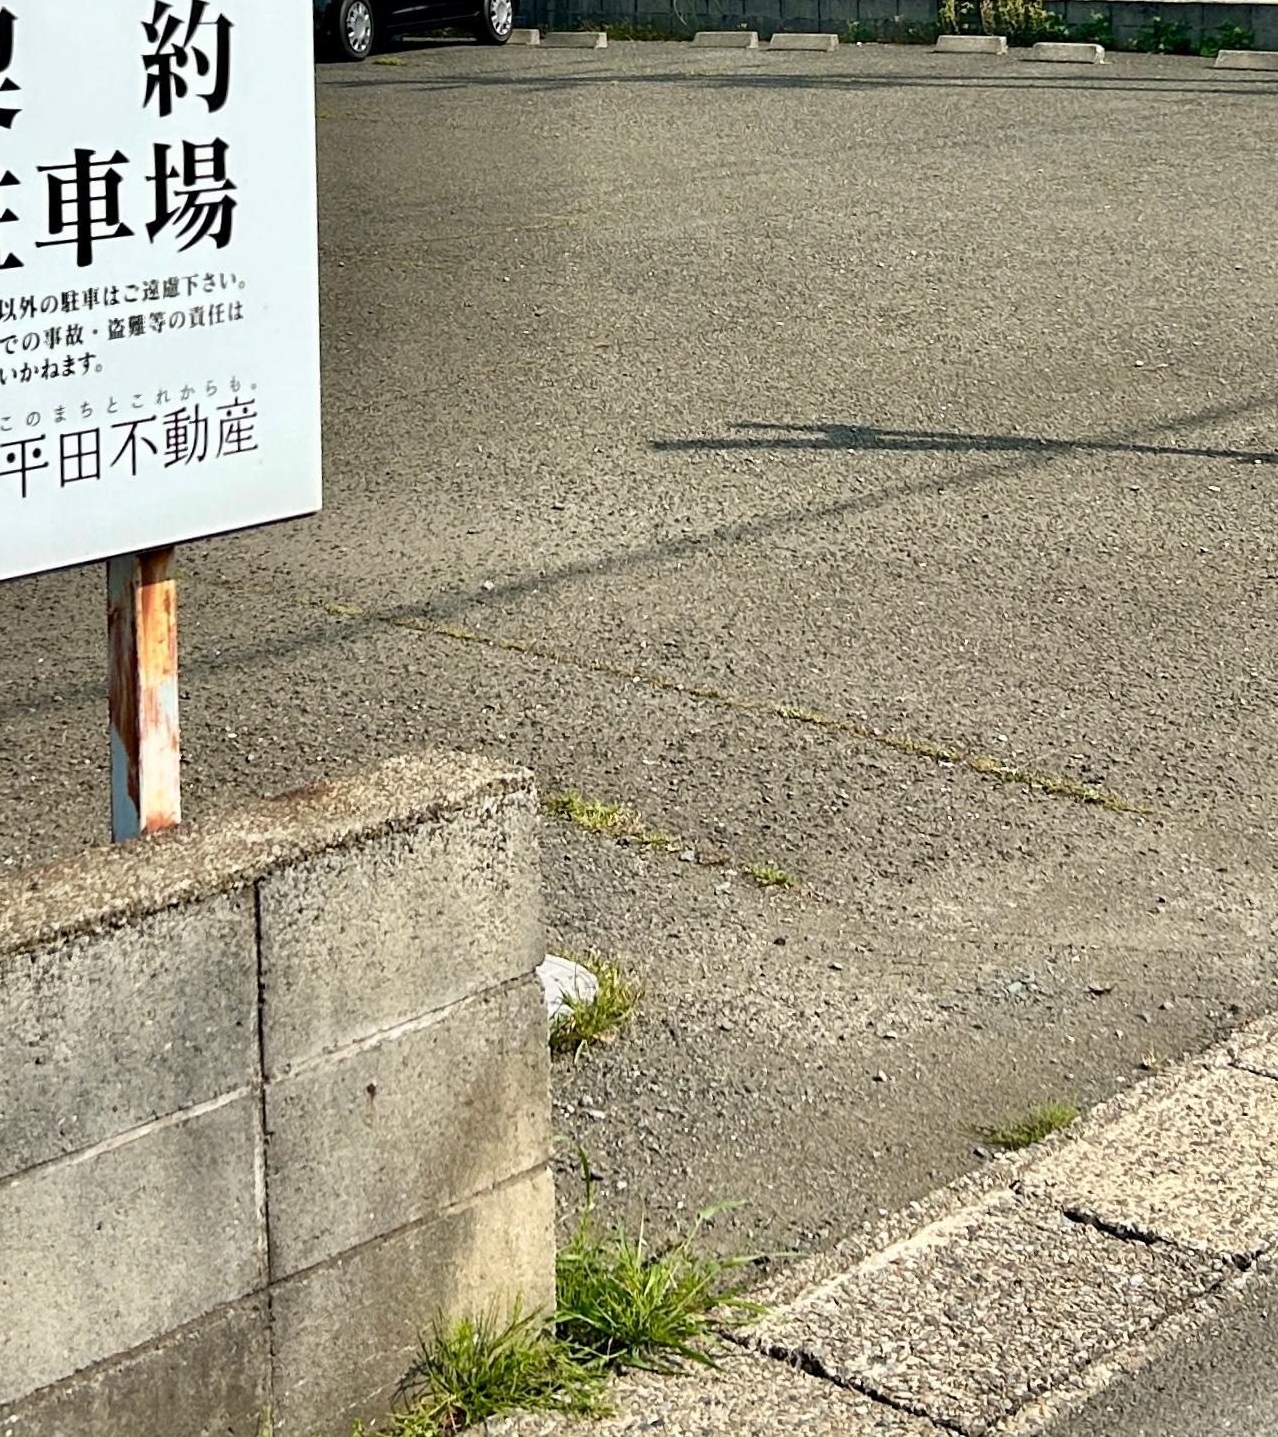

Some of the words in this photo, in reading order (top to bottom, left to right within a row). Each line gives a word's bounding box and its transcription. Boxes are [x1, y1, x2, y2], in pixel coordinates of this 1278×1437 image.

[0, 375, 258, 432] このまちとこれからも。
